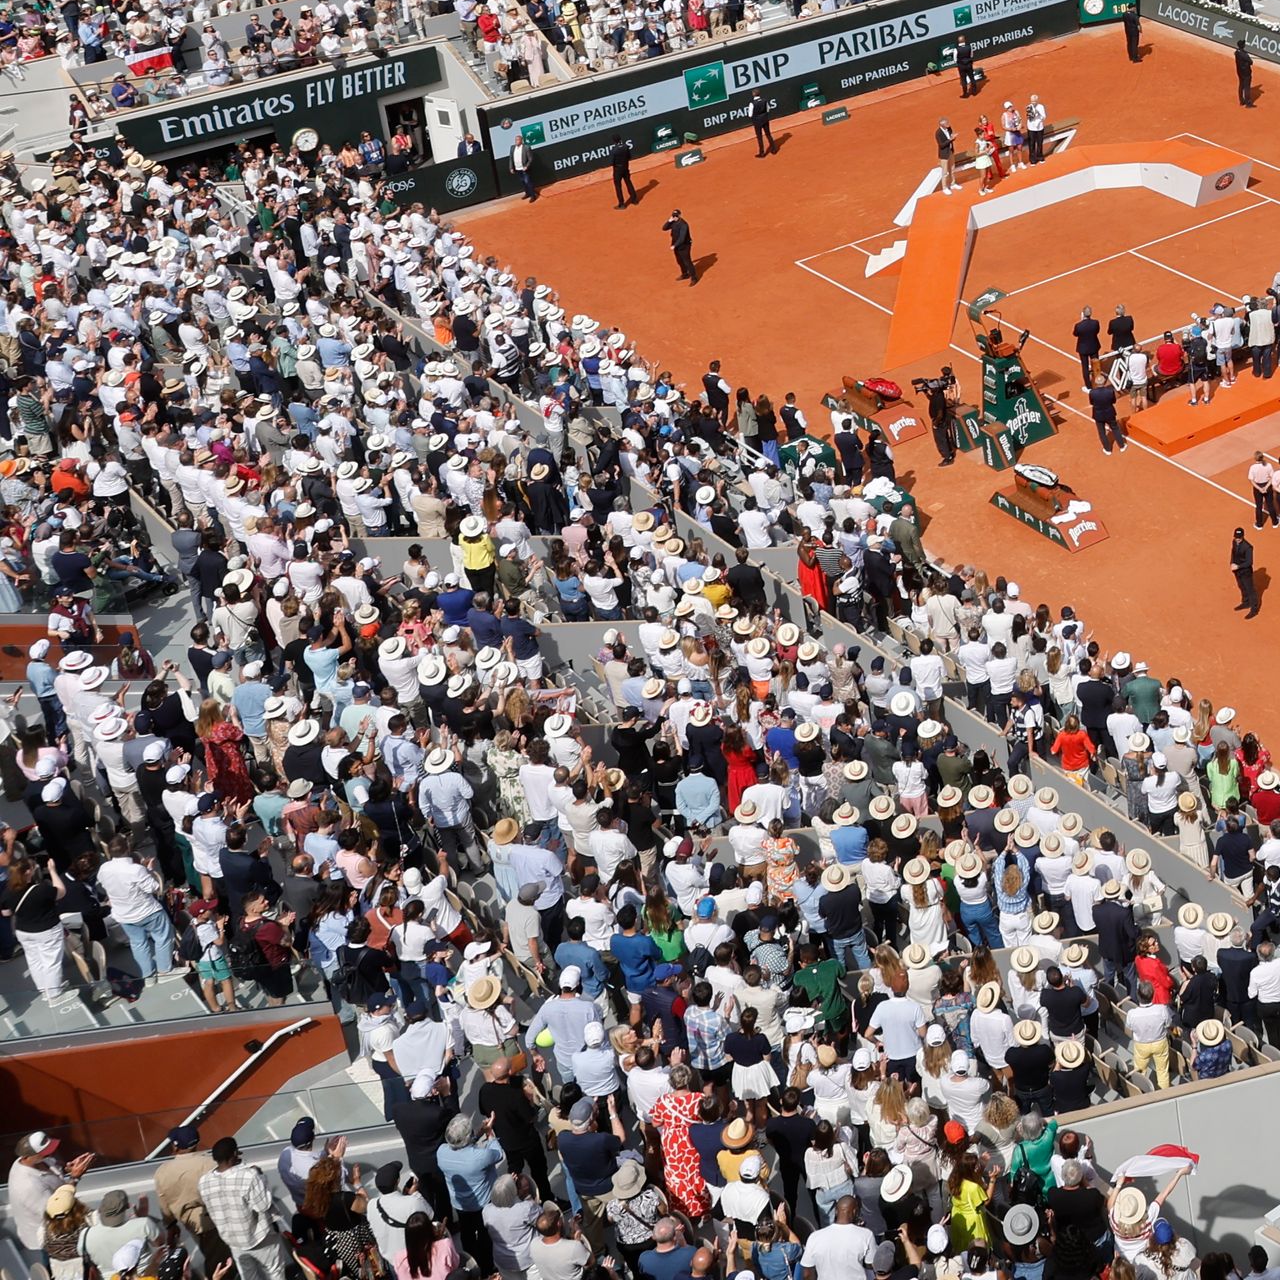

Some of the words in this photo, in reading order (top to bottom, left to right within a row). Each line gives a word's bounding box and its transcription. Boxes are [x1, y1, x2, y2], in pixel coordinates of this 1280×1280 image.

[1158, 2, 1210, 31] LACOSTE
[732, 52, 790, 89] BNP
[818, 13, 930, 66] PARIBAS
[970, 39, 991, 53] BNP
[992, 25, 1034, 46] PARIBAS
[840, 74, 864, 89] BNP
[865, 61, 910, 81] PARIBAS
[158, 93, 295, 144] Emirates
[306, 77, 336, 109] FLY
[341, 60, 406, 100] BETTER
[548, 113, 580, 132] BNP
[583, 95, 646, 123] PARIBAS
[703, 111, 728, 128] BNP
[729, 98, 777, 121] PARS
[826, 111, 846, 122] LACOSTE
[553, 157, 579, 171] BNP
[582, 139, 634, 163] PARIS
[655, 139, 678, 150] LACOSTE
[888, 416, 916, 441] Perrier
[999, 433, 1013, 461] Wilson
[1068, 520, 1098, 547] Perrier
[170, 988, 191, 1001] 07
